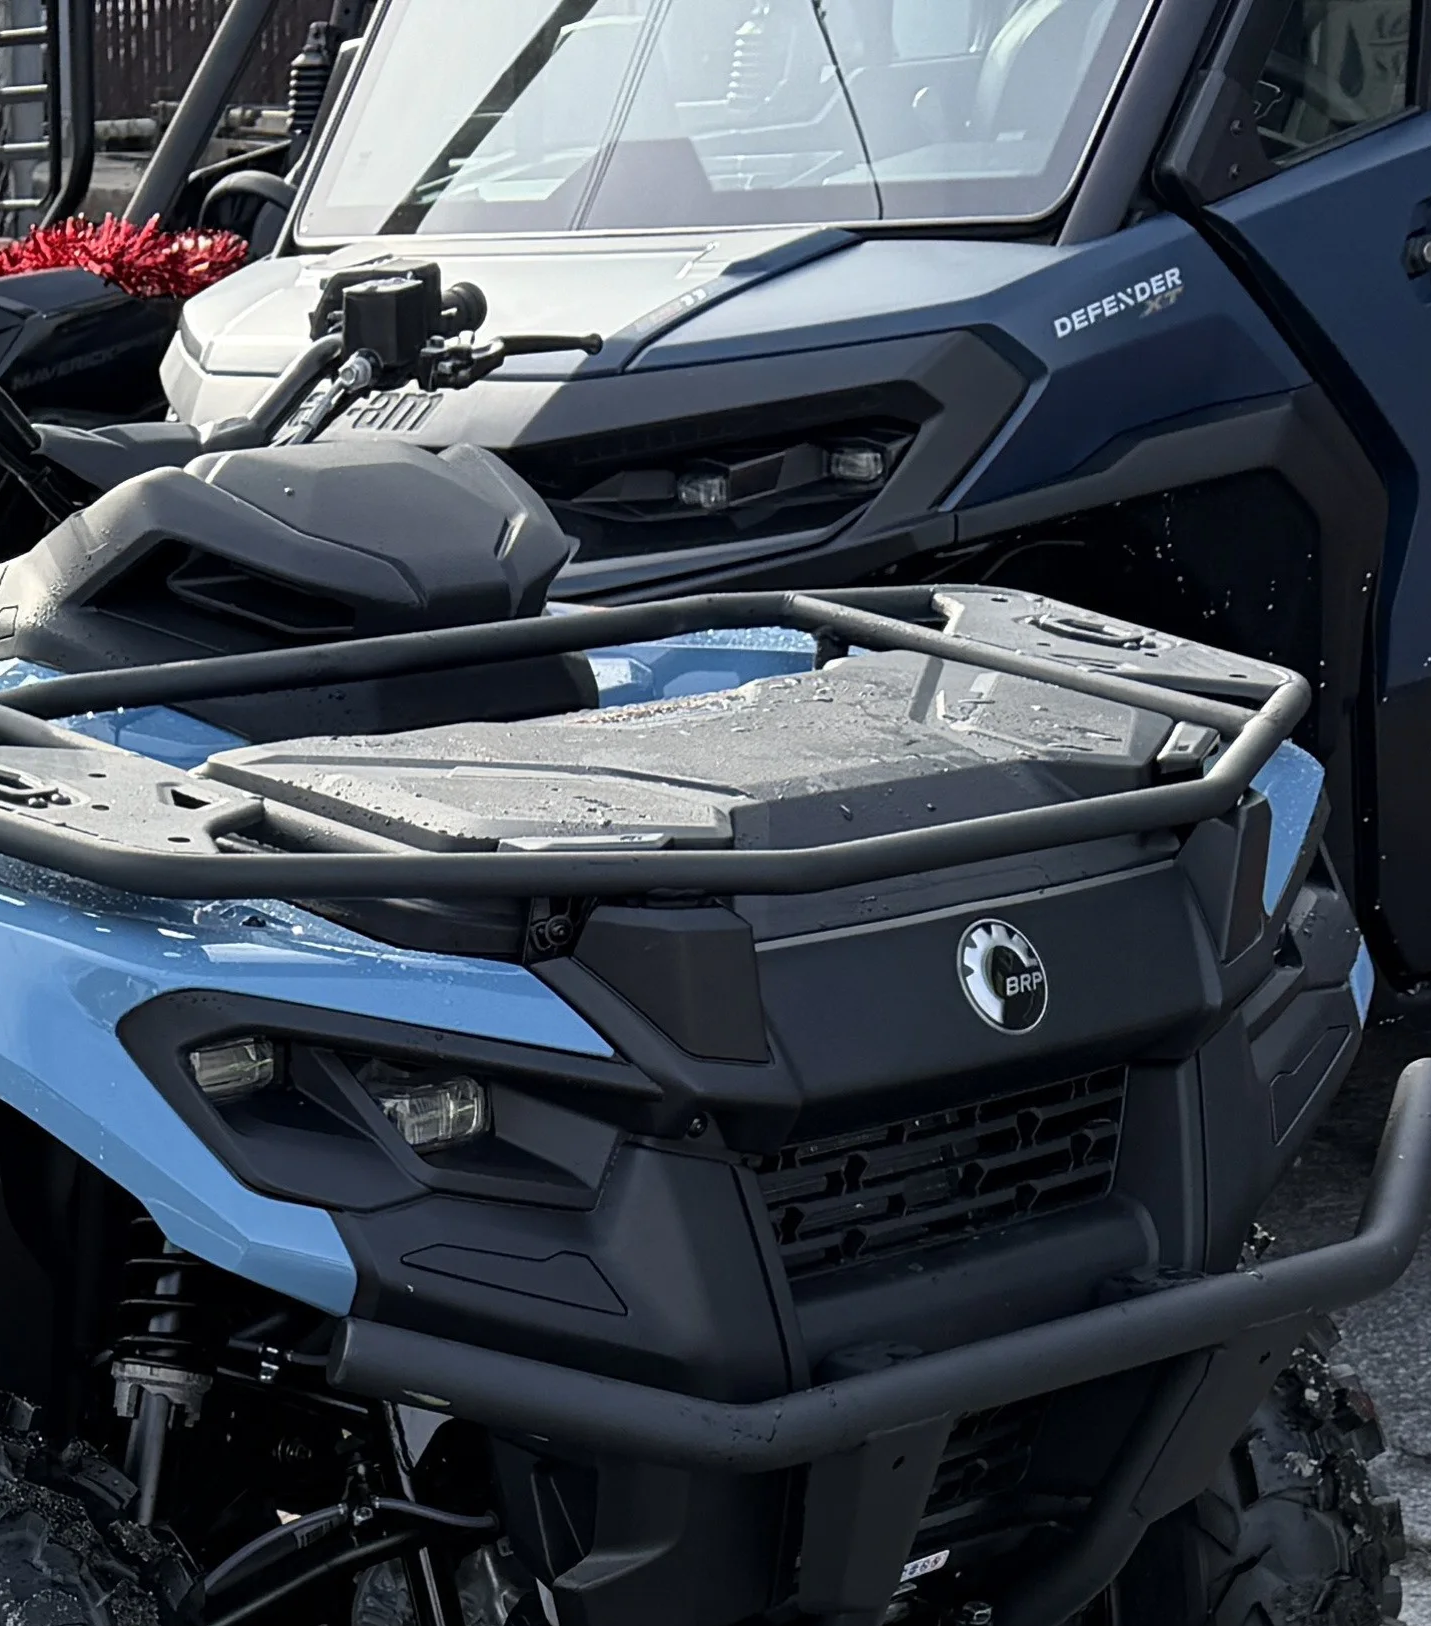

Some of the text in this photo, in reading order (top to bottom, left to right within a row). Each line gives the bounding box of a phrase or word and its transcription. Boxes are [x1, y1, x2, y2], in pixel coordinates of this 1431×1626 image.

[1053, 266, 1183, 338] DEFENDER
[1139, 286, 1185, 319] XT
[1005, 971, 1044, 997] BRP
